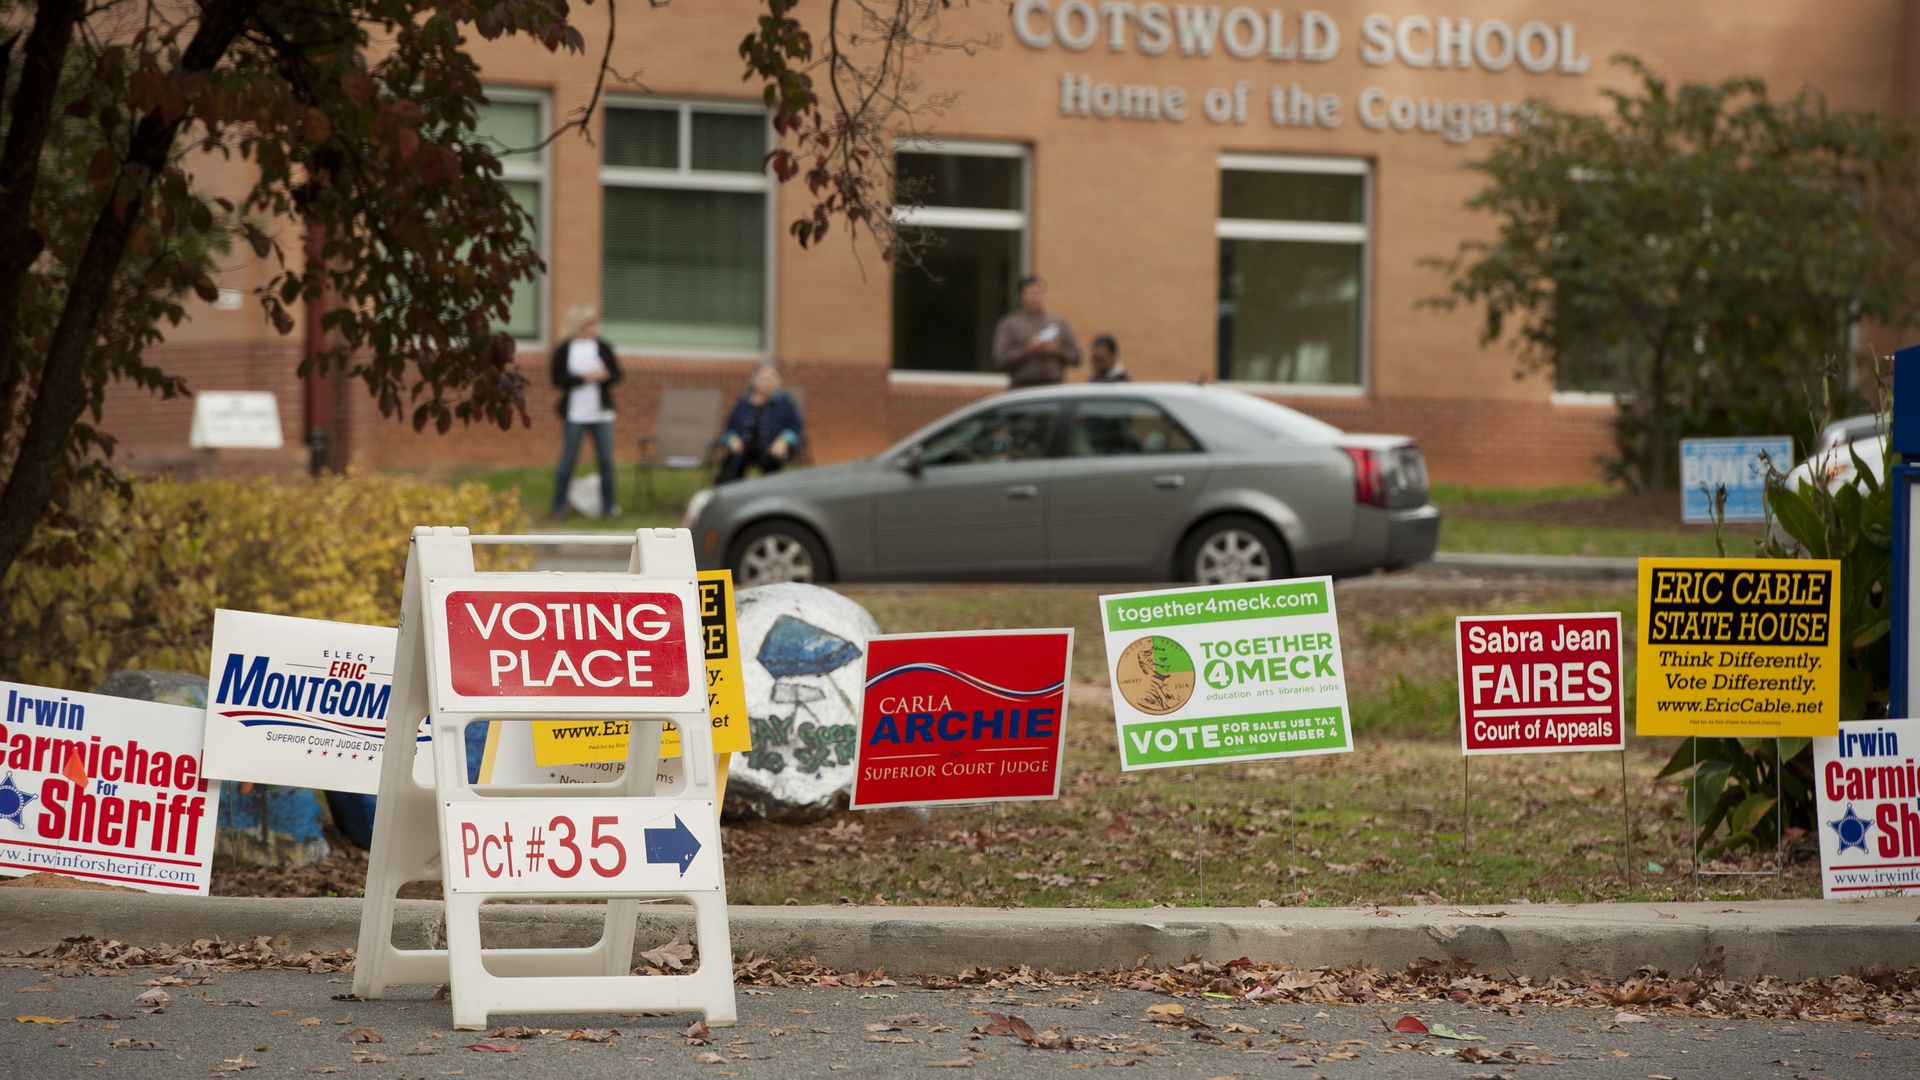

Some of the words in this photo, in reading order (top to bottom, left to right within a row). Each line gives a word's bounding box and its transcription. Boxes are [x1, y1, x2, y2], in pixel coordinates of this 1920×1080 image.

[1012, 0, 1340, 61] COTSWOLD
[1361, 15, 1591, 74] SCHOOL
[1060, 73, 1188, 120] Home
[1205, 80, 1252, 123] of
[1271, 84, 1342, 127] the
[1654, 571, 1724, 604] ERIC
[1731, 572, 1826, 606] CABLE
[1117, 589, 1318, 623] together4meck.com
[465, 602, 671, 641] VOTING
[1652, 610, 1732, 641] STATE
[1737, 612, 1828, 642] HOUSE
[1200, 632, 1333, 659] TOGETHER
[1468, 625, 1543, 654] Sabra
[1551, 624, 1611, 651] Jean
[323, 650, 376, 663] ELECT
[329, 661, 367, 680] ERIC
[490, 650, 653, 687] PLACE
[1659, 651, 1714, 667] Think
[1718, 651, 1822, 672] Differently.
[215, 653, 392, 720] MONTGOM
[1206, 689, 1252, 701] education
[1256, 688, 1274, 697] arts
[1278, 685, 1315, 695] libraries
[1319, 683, 1339, 694] jobs
[1472, 661, 1613, 704] FAIRES
[1665, 673, 1707, 689] Vote
[1712, 674, 1816, 695] Differently.
[6, 690, 85, 731] Irwin
[879, 695, 952, 714] CARLA
[1657, 698, 1823, 713] www.EricCable.net
[869, 708, 1055, 745] ARCHIE
[1130, 724, 1221, 754] VOTE
[1222, 722, 1250, 734] FOR
[1252, 719, 1287, 731] SALES
[1290, 717, 1312, 728] USE
[1315, 715, 1336, 726] TAX
[1224, 734, 1245, 746] ON
[1249, 728, 1325, 744] NOVEMBER
[1329, 727, 1338, 738] 4
[1474, 720, 1521, 742] Court
[1524, 720, 1541, 739] of
[1545, 717, 1613, 743] Appeals
[266, 731, 306, 744] SUPERIOR
[308, 735, 335, 747] COURT
[336, 739, 362, 751] JUDGE
[1839, 727, 1899, 758] Irwin
[864, 766, 936, 781] SUPERIOR
[941, 761, 995, 777] COURT
[1000, 760, 1049, 777] JUDGE
[1825, 759, 1920, 801] Carmi
[97, 780, 118, 796] For
[37, 778, 206, 856] Sheriff
